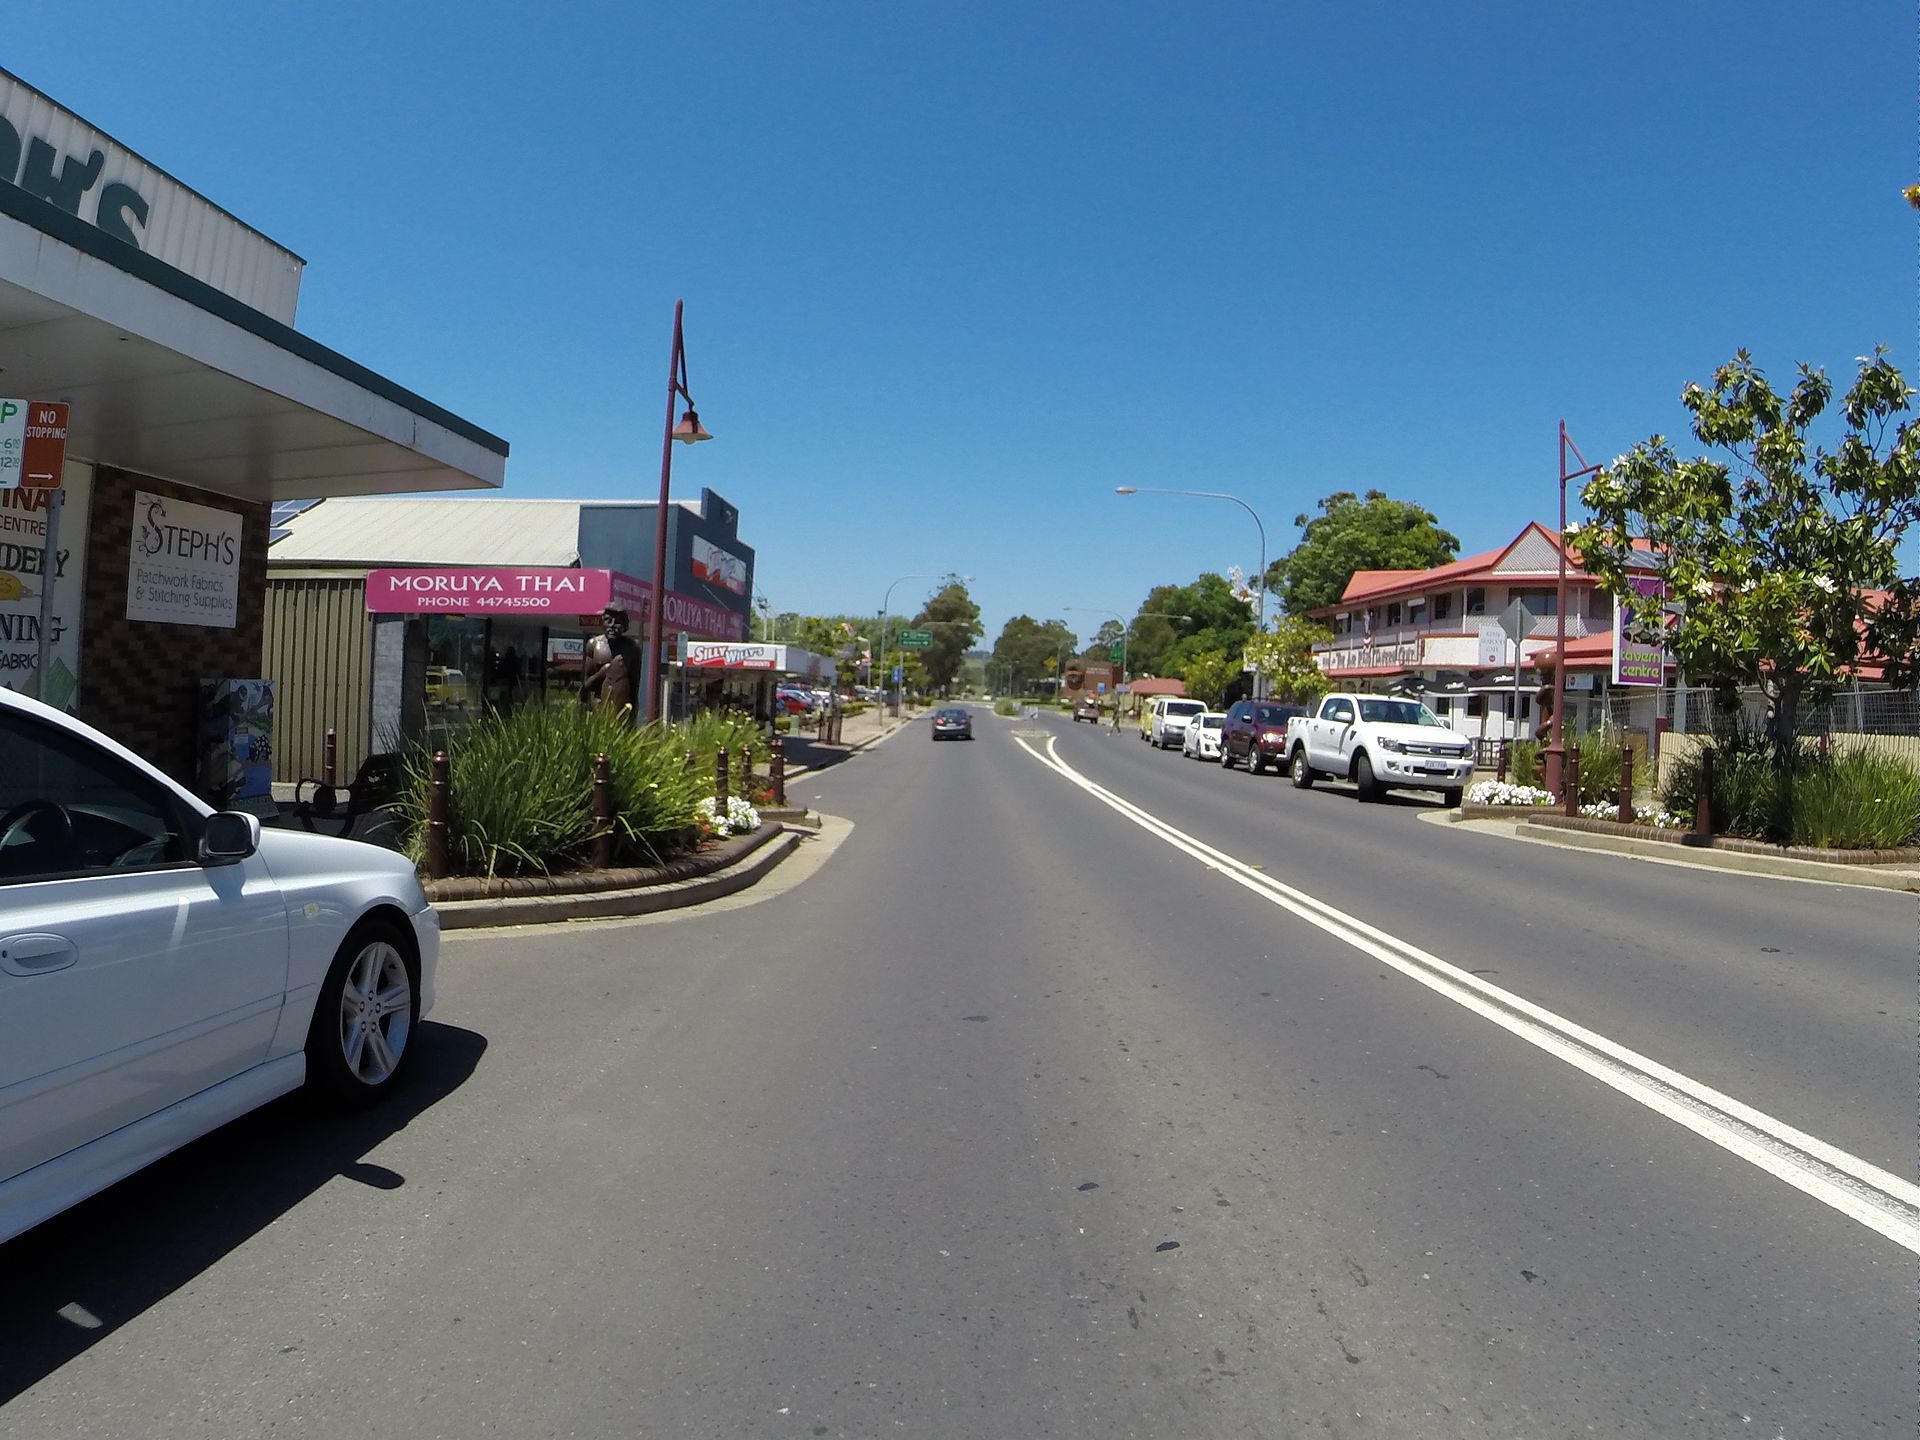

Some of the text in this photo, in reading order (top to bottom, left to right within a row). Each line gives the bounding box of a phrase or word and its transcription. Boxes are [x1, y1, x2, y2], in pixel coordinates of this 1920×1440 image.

[39, 410, 56, 424] NO
[26, 425, 66, 439] STOPPING
[143, 502, 235, 566] STEPH'S
[137, 568, 224, 593] Patchwork Fabrics
[390, 576, 585, 592] MORUYA THAI
[135, 586, 233, 610] & Stitching Supplies
[417, 597, 550, 607] PHONE 44745500
[704, 607, 726, 633] THAI
[694, 646, 764, 664] SILLY WILLY'S
[1620, 648, 1661, 663] tavern
[1621, 664, 1660, 678] centre
